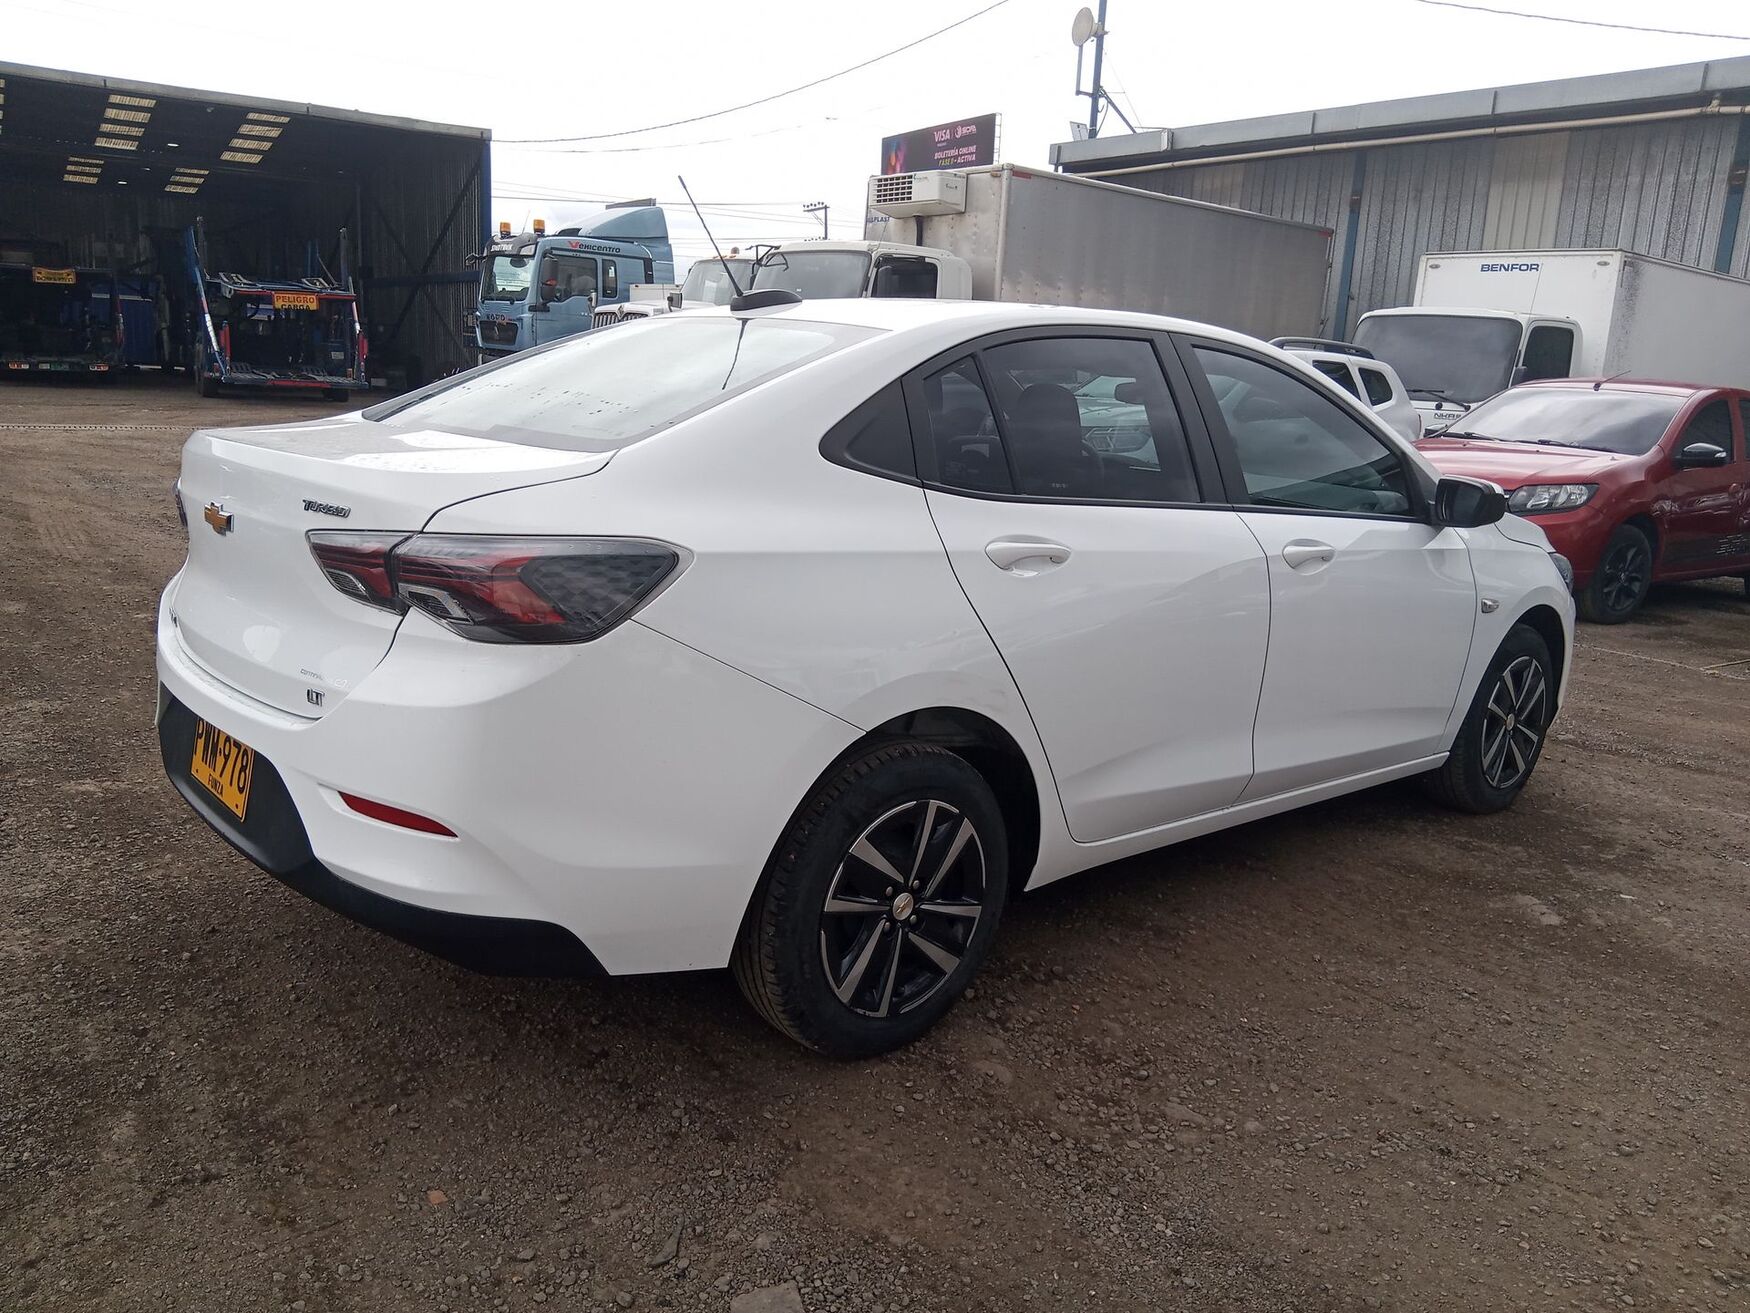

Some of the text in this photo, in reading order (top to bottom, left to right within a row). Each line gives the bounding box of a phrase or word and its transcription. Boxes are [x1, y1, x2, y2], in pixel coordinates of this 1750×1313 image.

[934, 129, 950, 142] VISA
[957, 154, 976, 163] ACTIVA
[1480, 263, 1540, 272] BENFOR
[275, 295, 315, 304] PELIGRO
[306, 688, 325, 708] LT
[207, 773, 224, 798] FUNZA
